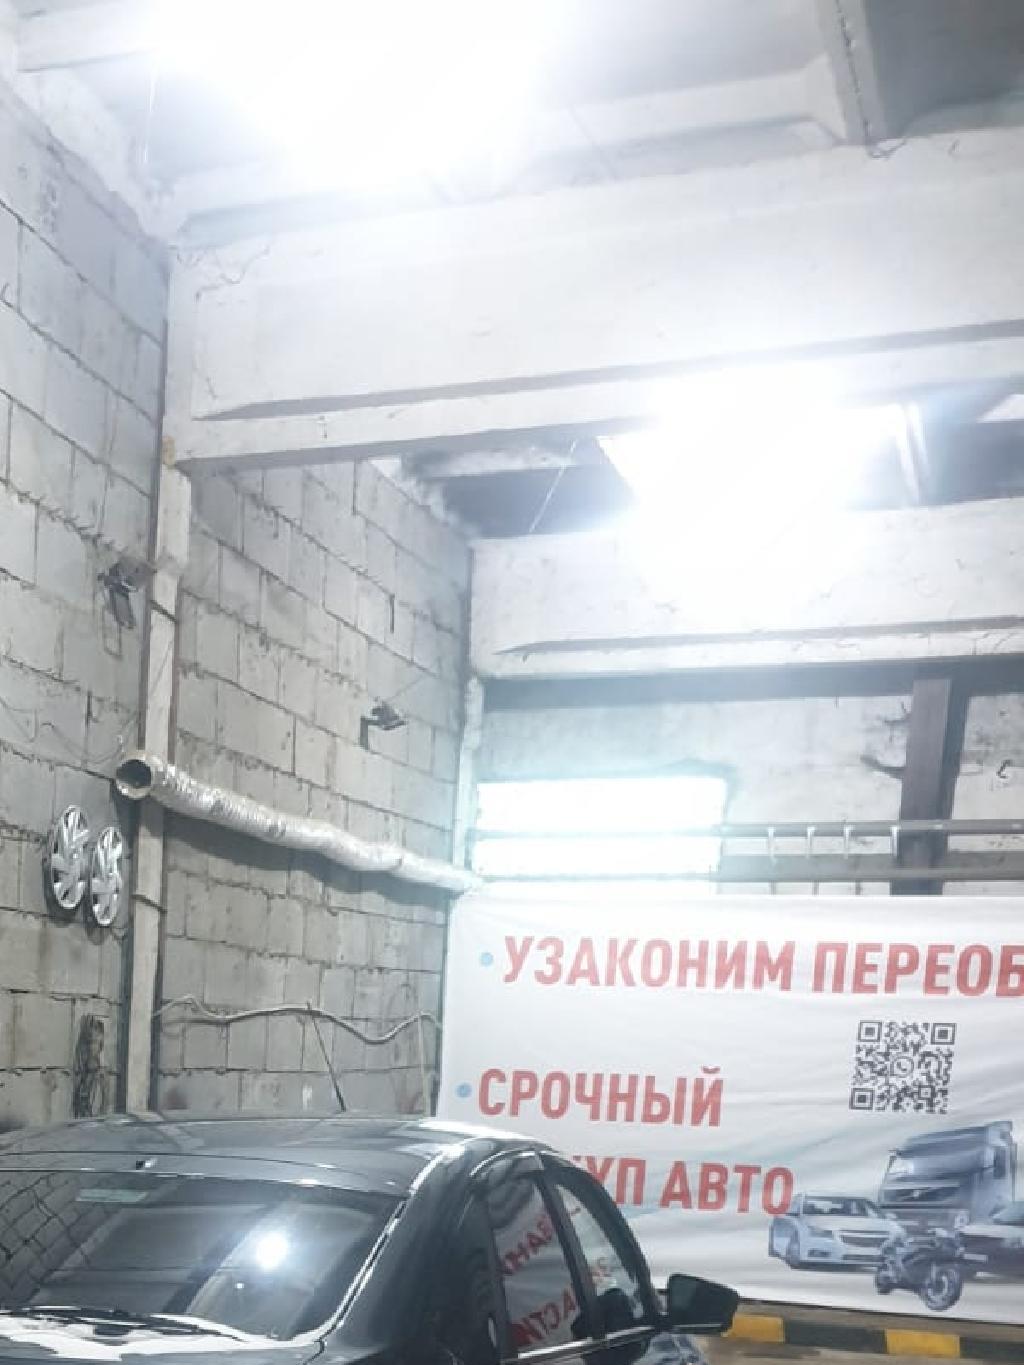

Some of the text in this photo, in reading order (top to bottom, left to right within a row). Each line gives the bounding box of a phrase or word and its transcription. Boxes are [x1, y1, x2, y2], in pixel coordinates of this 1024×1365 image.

[503, 935, 1024, 998] УЗАКОНИМ ПЕРЕОБ
[479, 1067, 725, 1127] СРОЧНЫЙ
[573, 1155, 794, 1216] УП АВТО
